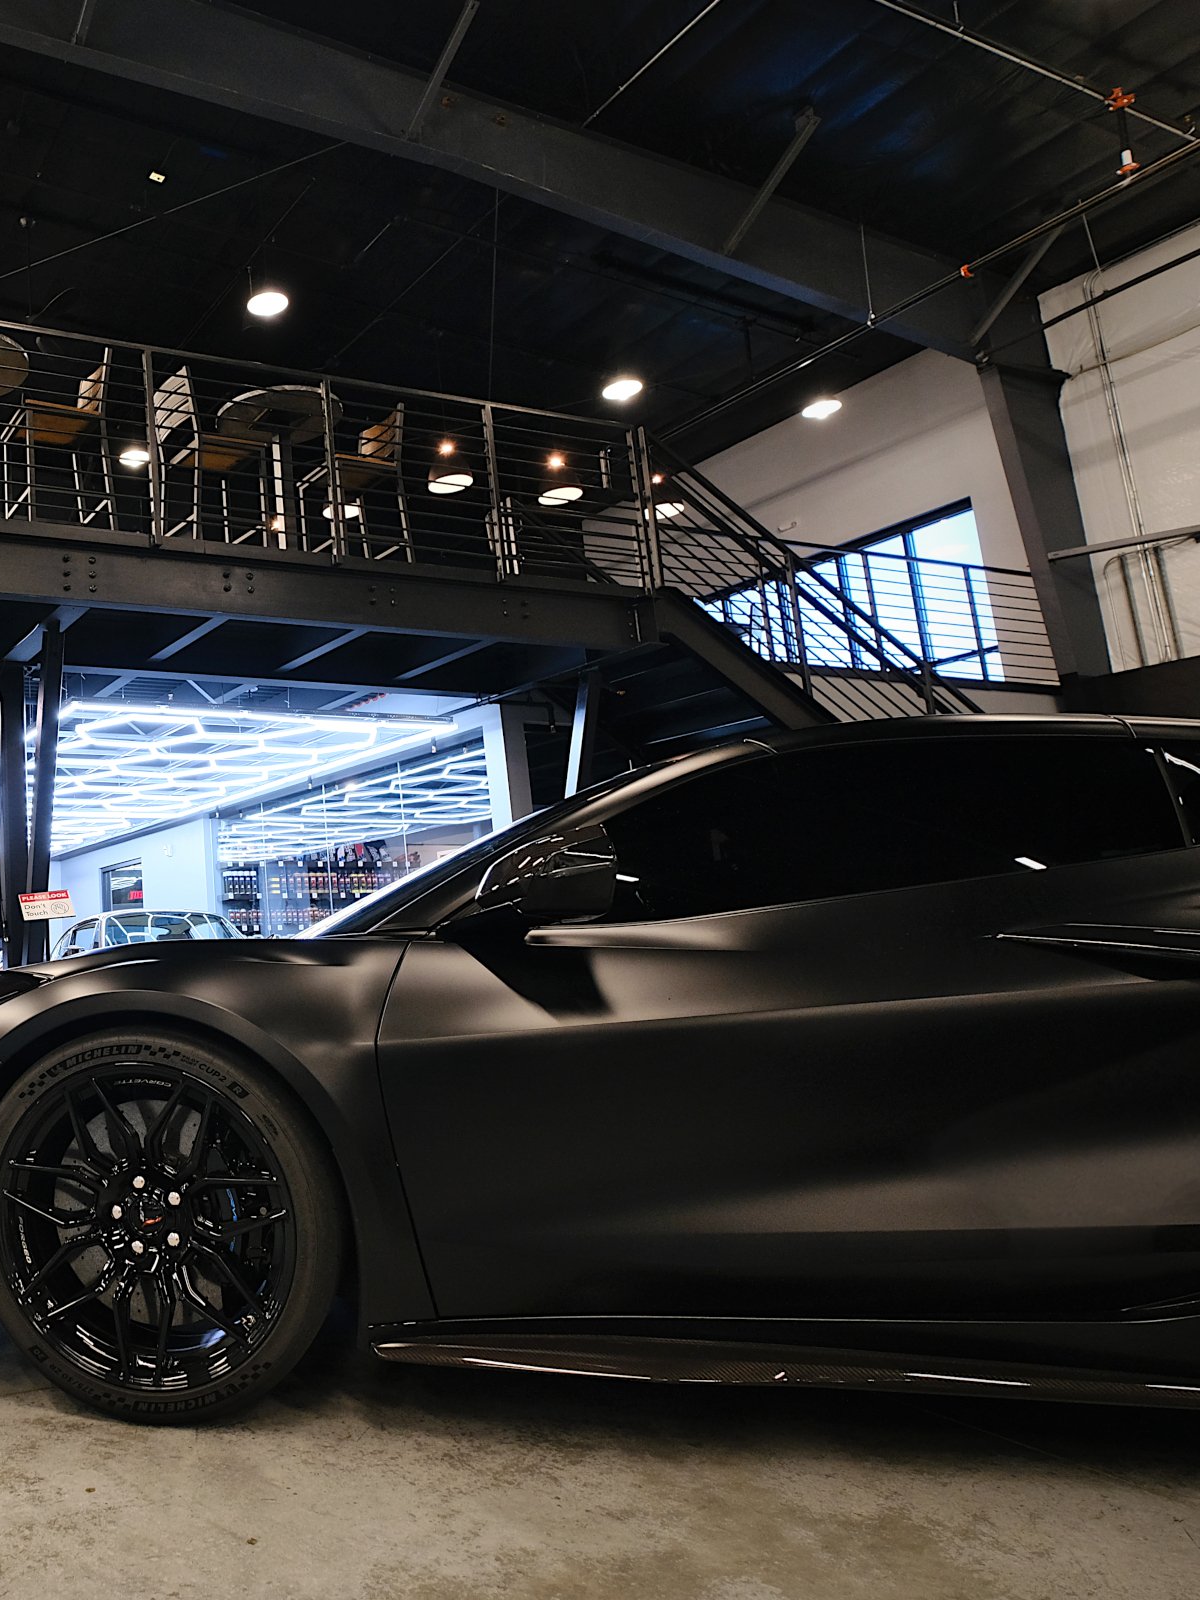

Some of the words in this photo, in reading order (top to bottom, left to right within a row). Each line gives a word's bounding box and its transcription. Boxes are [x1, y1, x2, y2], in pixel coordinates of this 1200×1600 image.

[21, 894, 47, 902] PLEASE
[65, 1045, 139, 1069] MICHELIN
[18, 1216, 32, 1264] FORGED
[136, 1392, 217, 1412] MICHELIN
